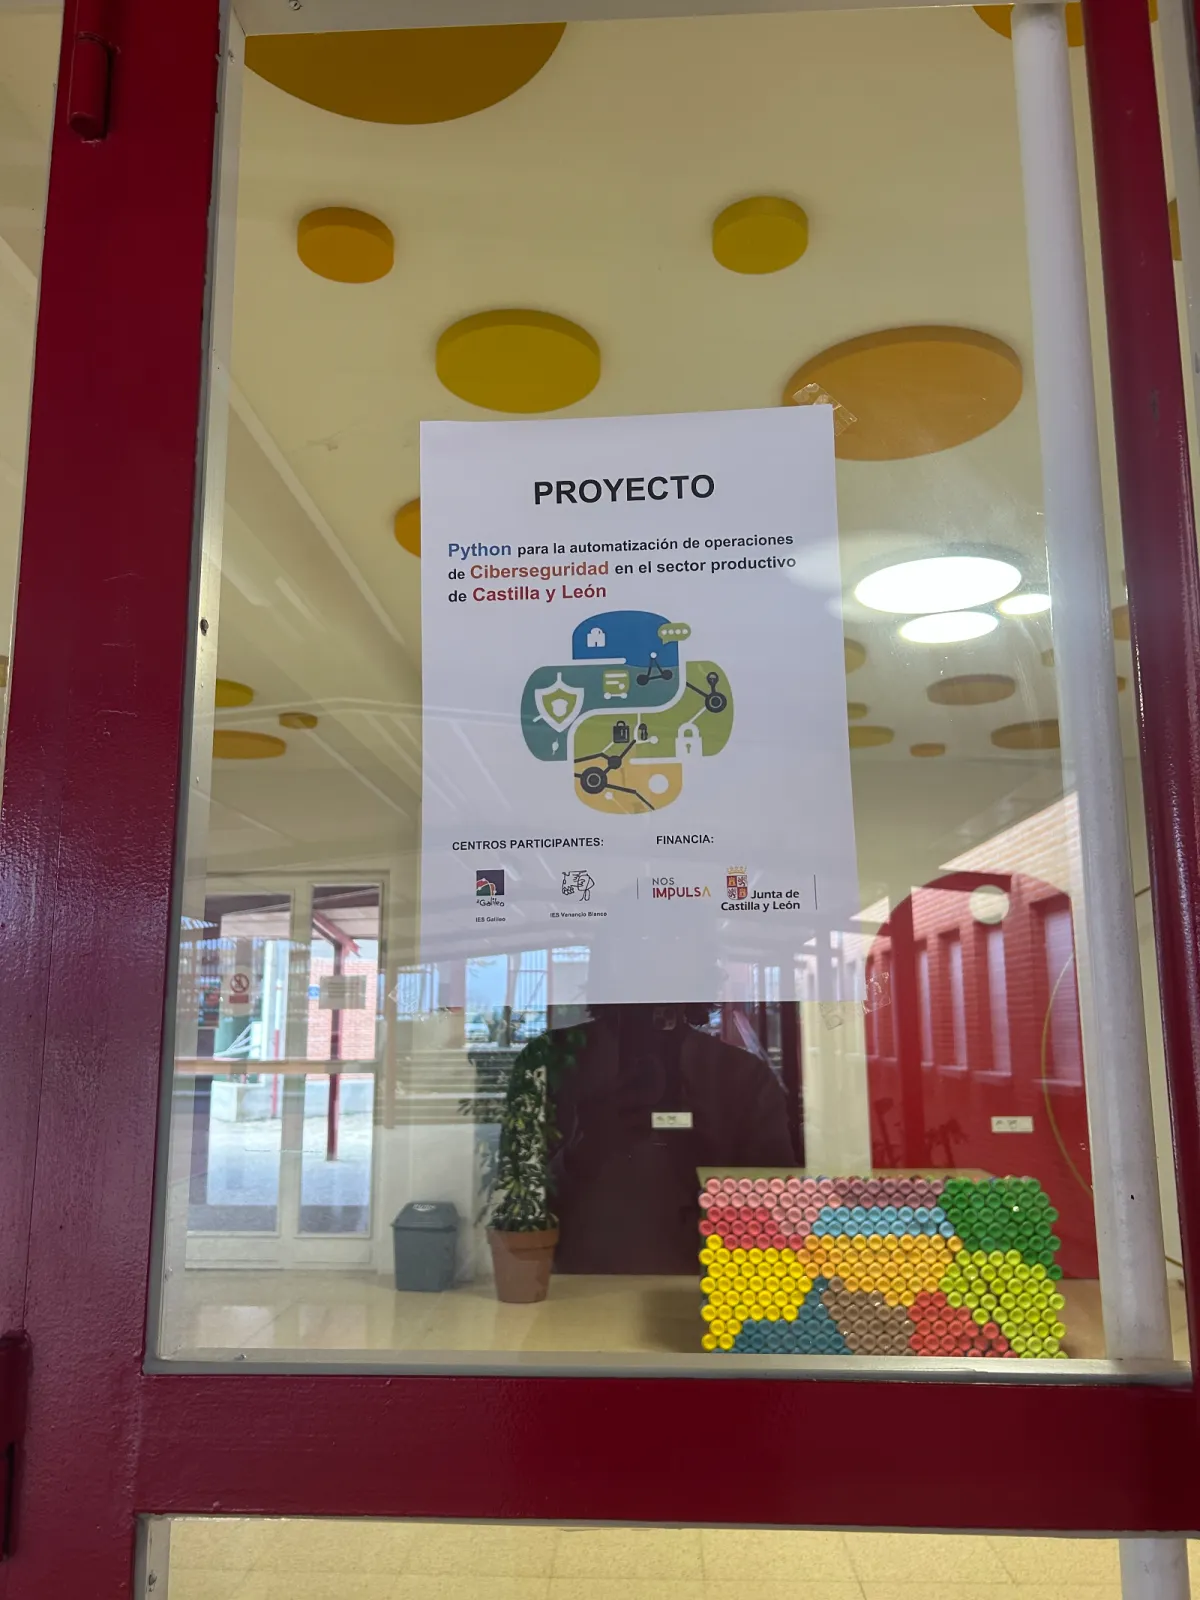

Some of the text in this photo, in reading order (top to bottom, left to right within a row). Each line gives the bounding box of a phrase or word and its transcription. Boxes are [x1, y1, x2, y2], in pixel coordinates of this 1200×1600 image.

[534, 474, 715, 506] PROYECTO
[448, 534, 794, 560] Python para la automatización de operaciones
[447, 555, 797, 581] de Ciberseguridad en el sector productivo
[447, 582, 607, 604] de Castilla y León
[451, 837, 605, 851] CENTROS PARTICIPANTES:
[656, 834, 715, 845] FINANCIA:
[652, 877, 675, 886] NOS
[750, 889, 800, 899] Junta de
[720, 900, 801, 912] Castilla y León
